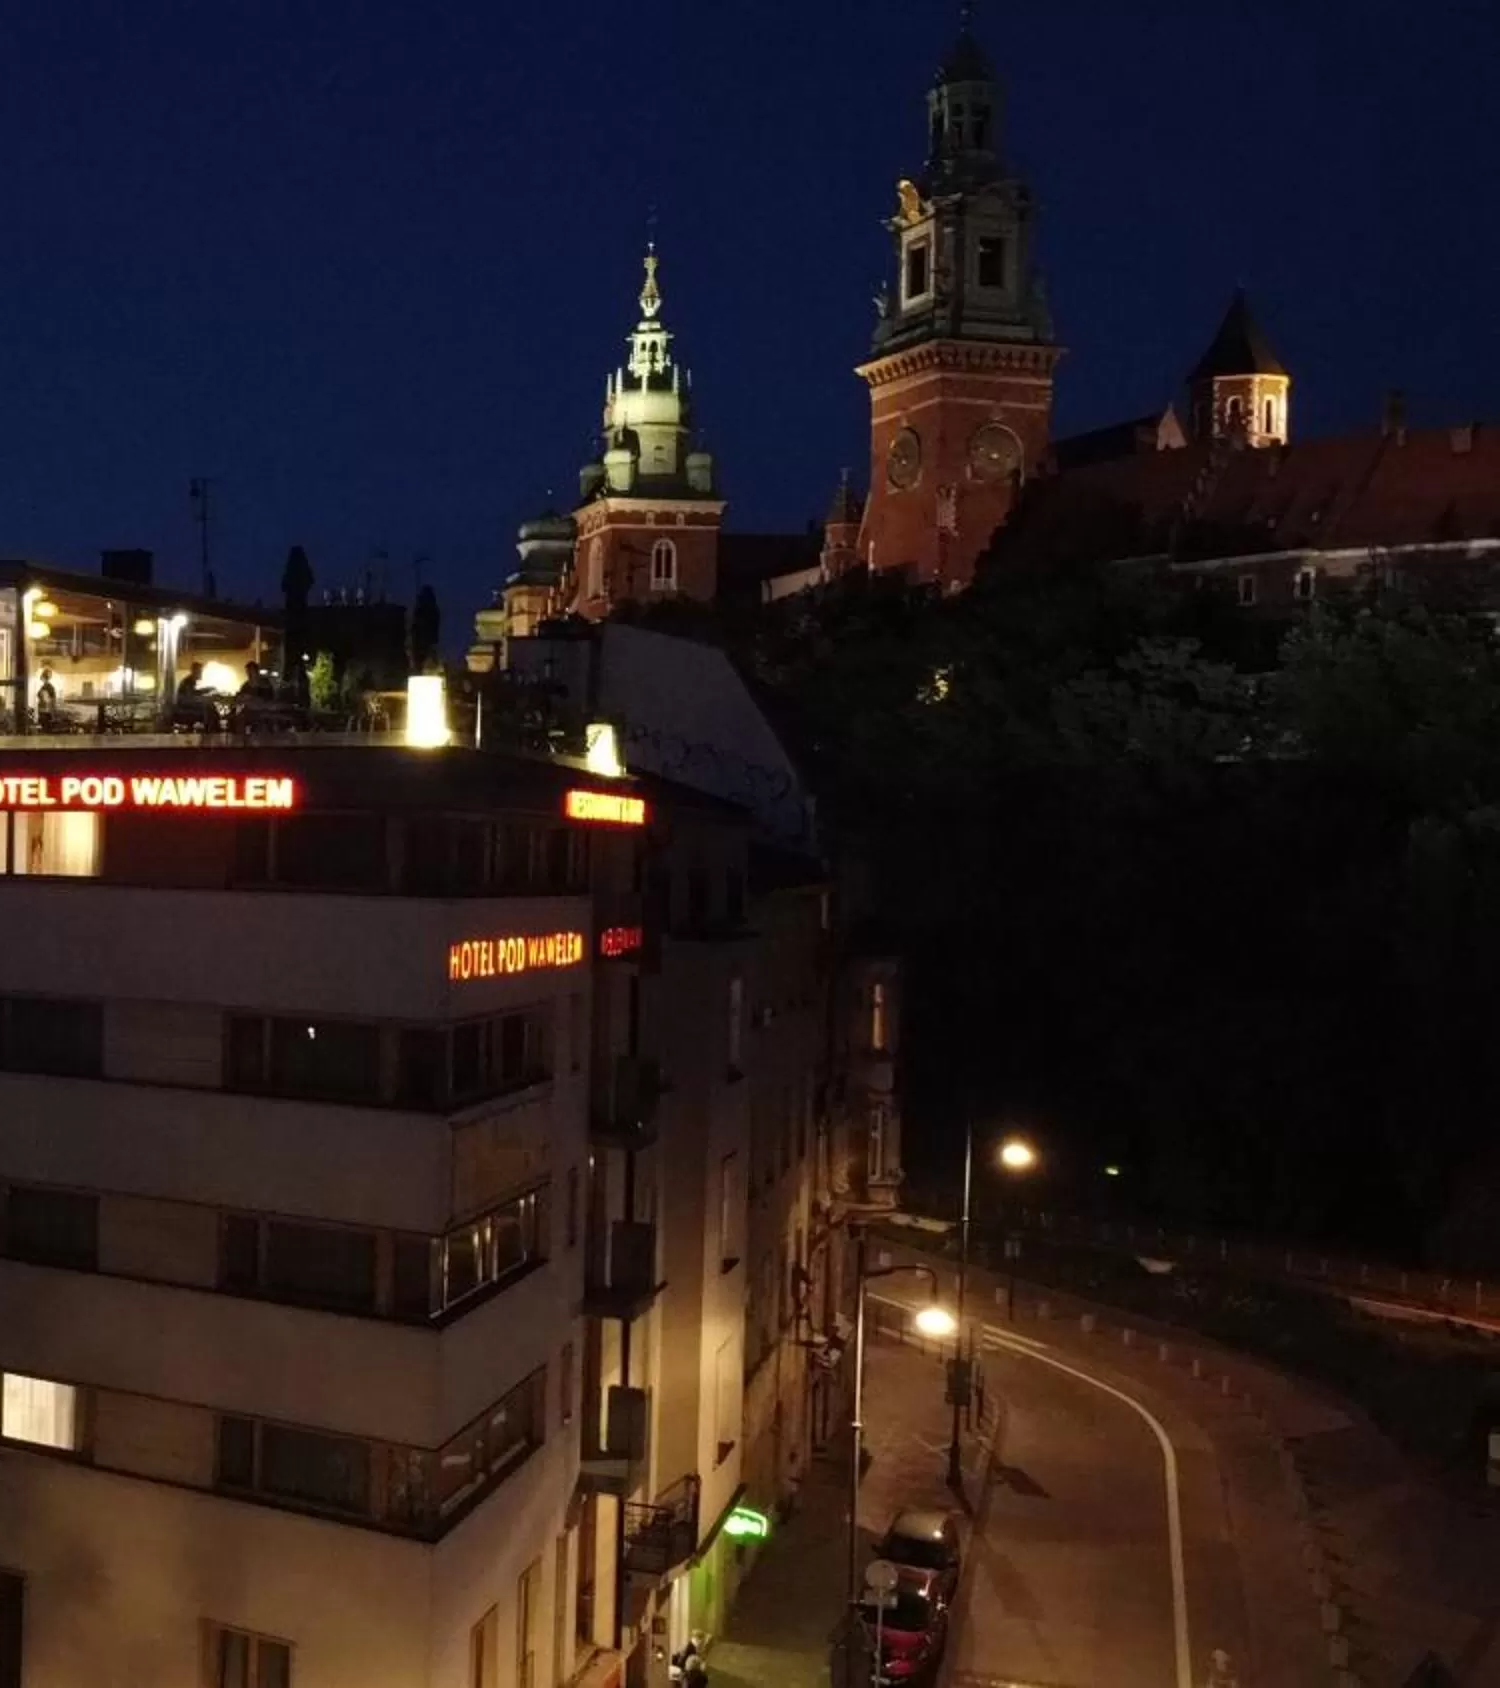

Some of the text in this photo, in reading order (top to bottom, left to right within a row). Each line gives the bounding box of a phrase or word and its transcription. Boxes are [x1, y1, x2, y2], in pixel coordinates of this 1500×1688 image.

[61, 777, 125, 806] POD
[130, 777, 294, 808] WAWELEM
[449, 940, 495, 980] HOTEL
[498, 936, 526, 973] POD
[526, 931, 582, 967] WAWELEM
